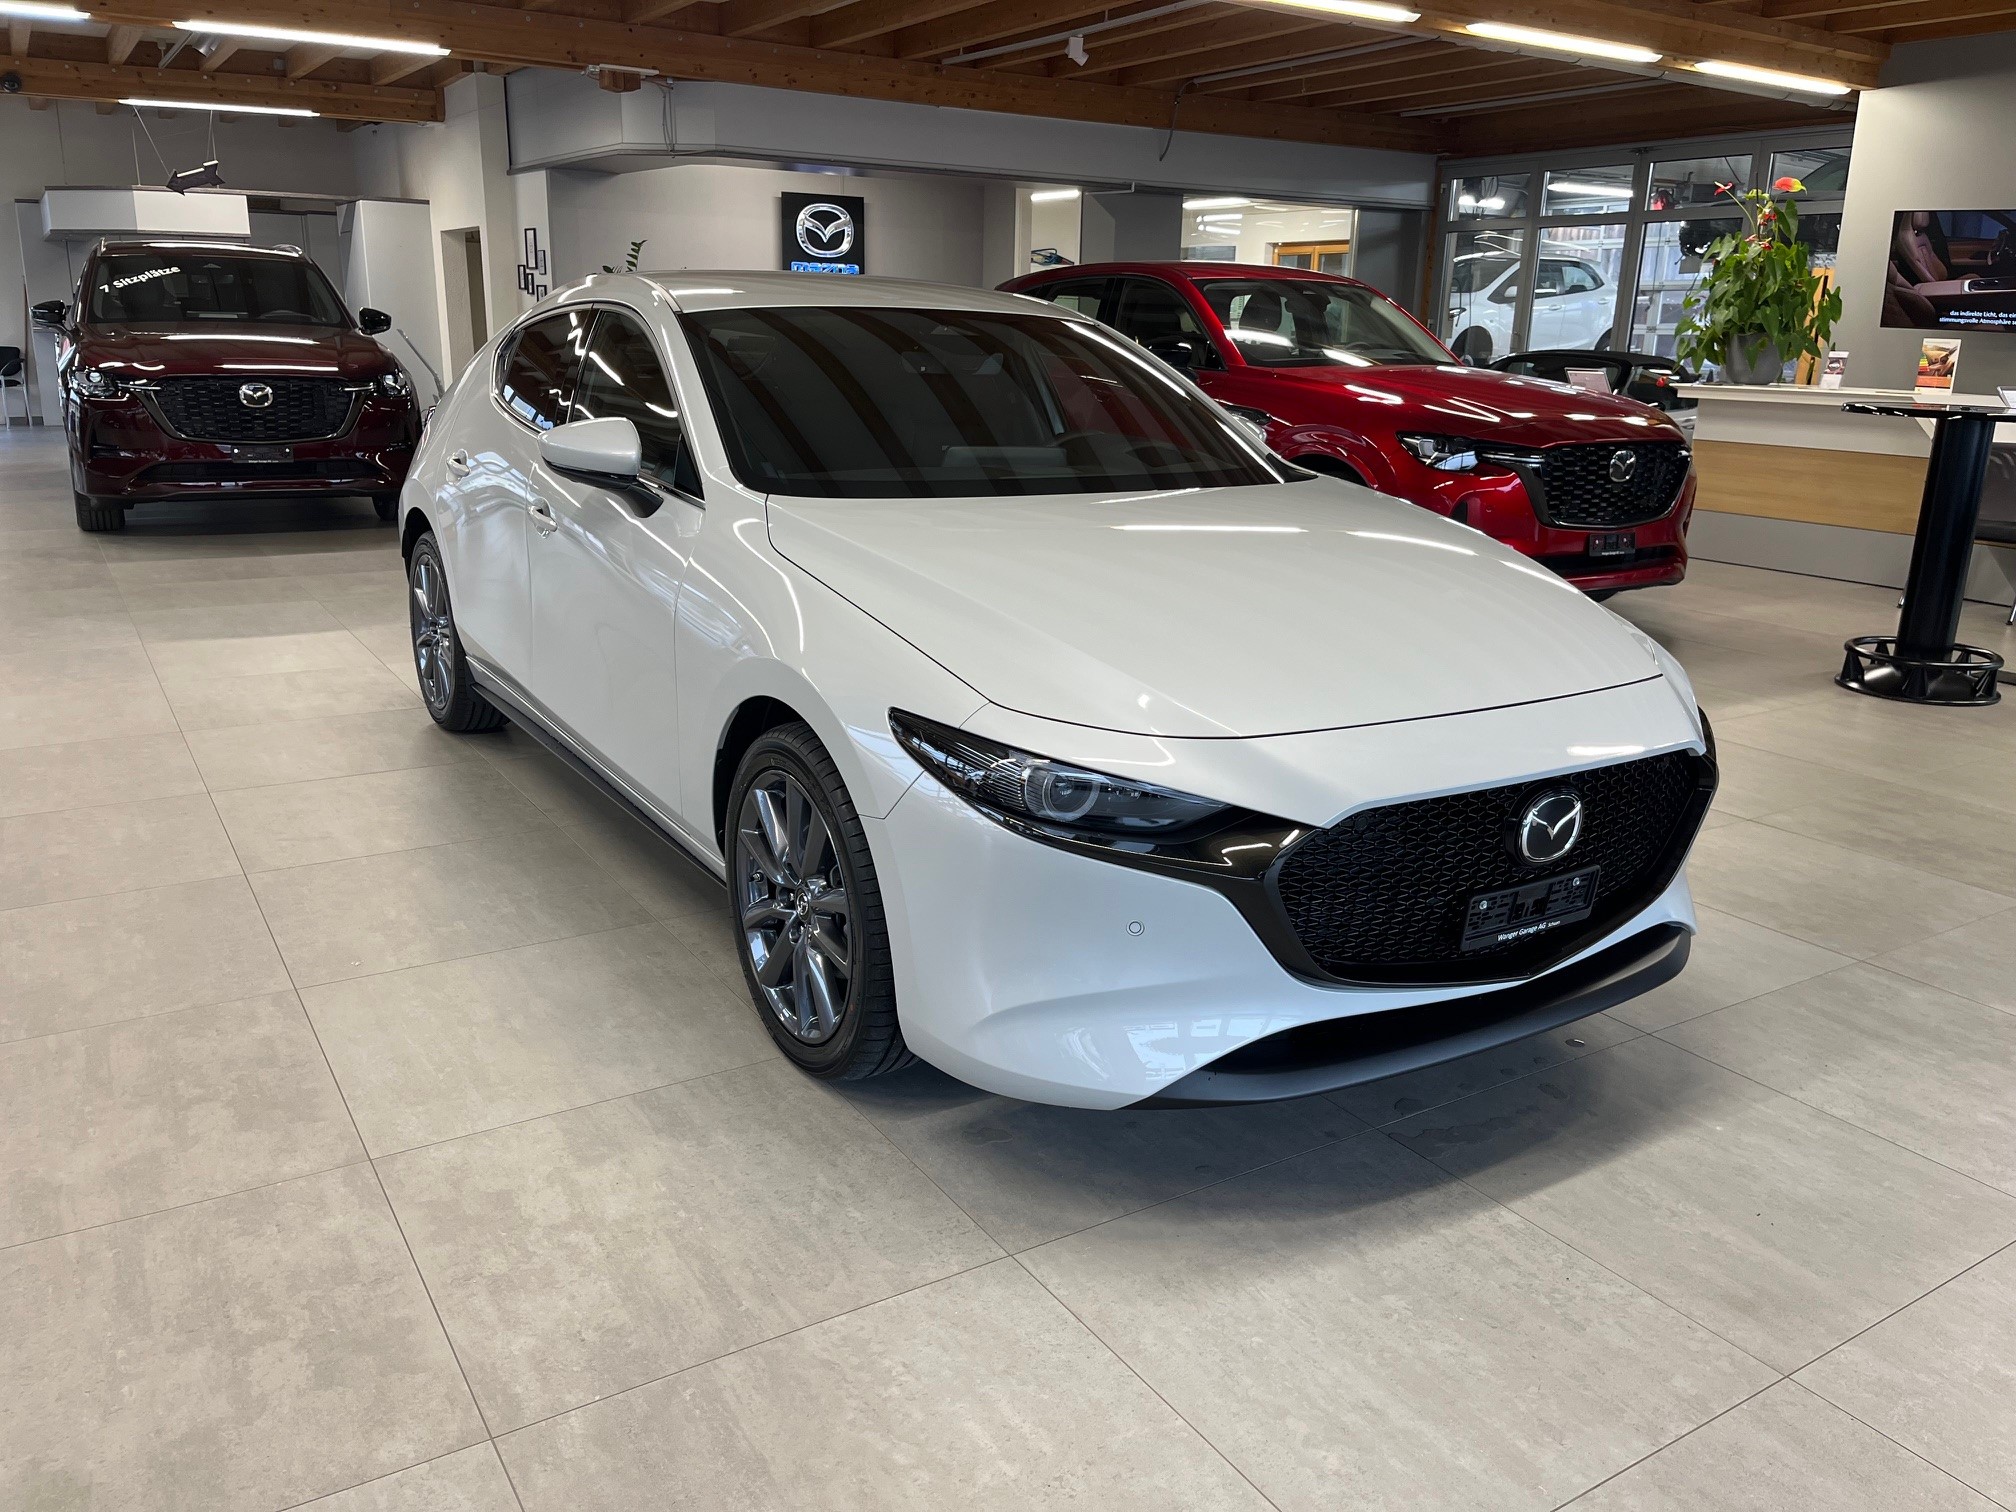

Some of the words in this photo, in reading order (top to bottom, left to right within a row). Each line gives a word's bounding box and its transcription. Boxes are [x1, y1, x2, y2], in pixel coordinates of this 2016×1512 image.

[99, 284, 109, 293] 7
[112, 266, 181, 289] Sitzplätze
[1519, 926, 1538, 935] Garage
[1538, 922, 1547, 930] AG
